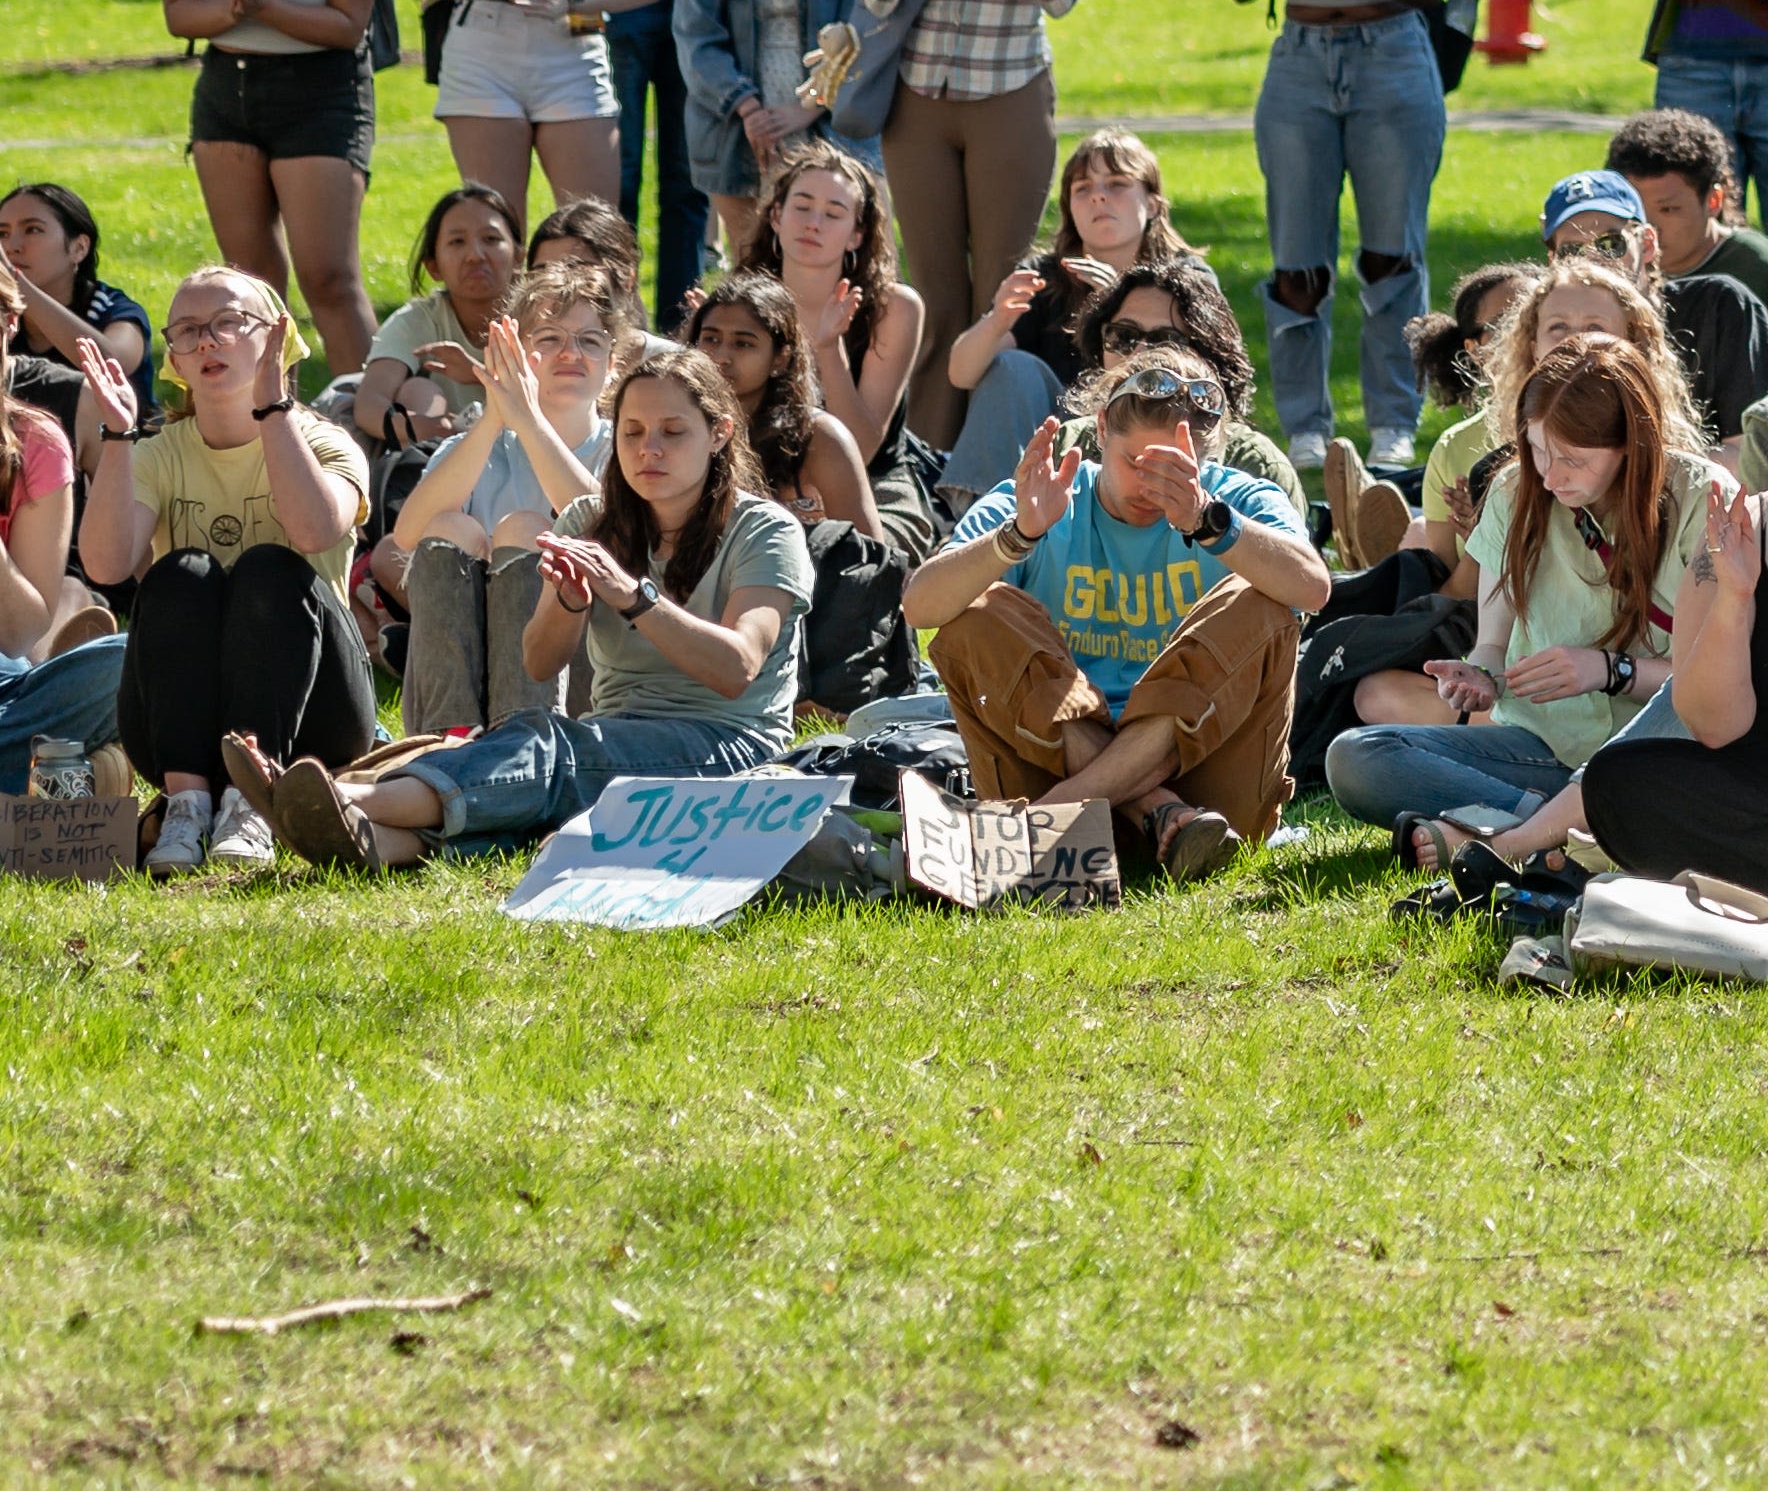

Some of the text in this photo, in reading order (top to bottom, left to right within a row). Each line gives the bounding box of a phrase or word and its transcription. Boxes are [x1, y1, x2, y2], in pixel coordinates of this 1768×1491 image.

[0, 801, 120, 824] IBERATION
[591, 782, 825, 852] Justice
[24, 823, 106, 842] IS NOT
